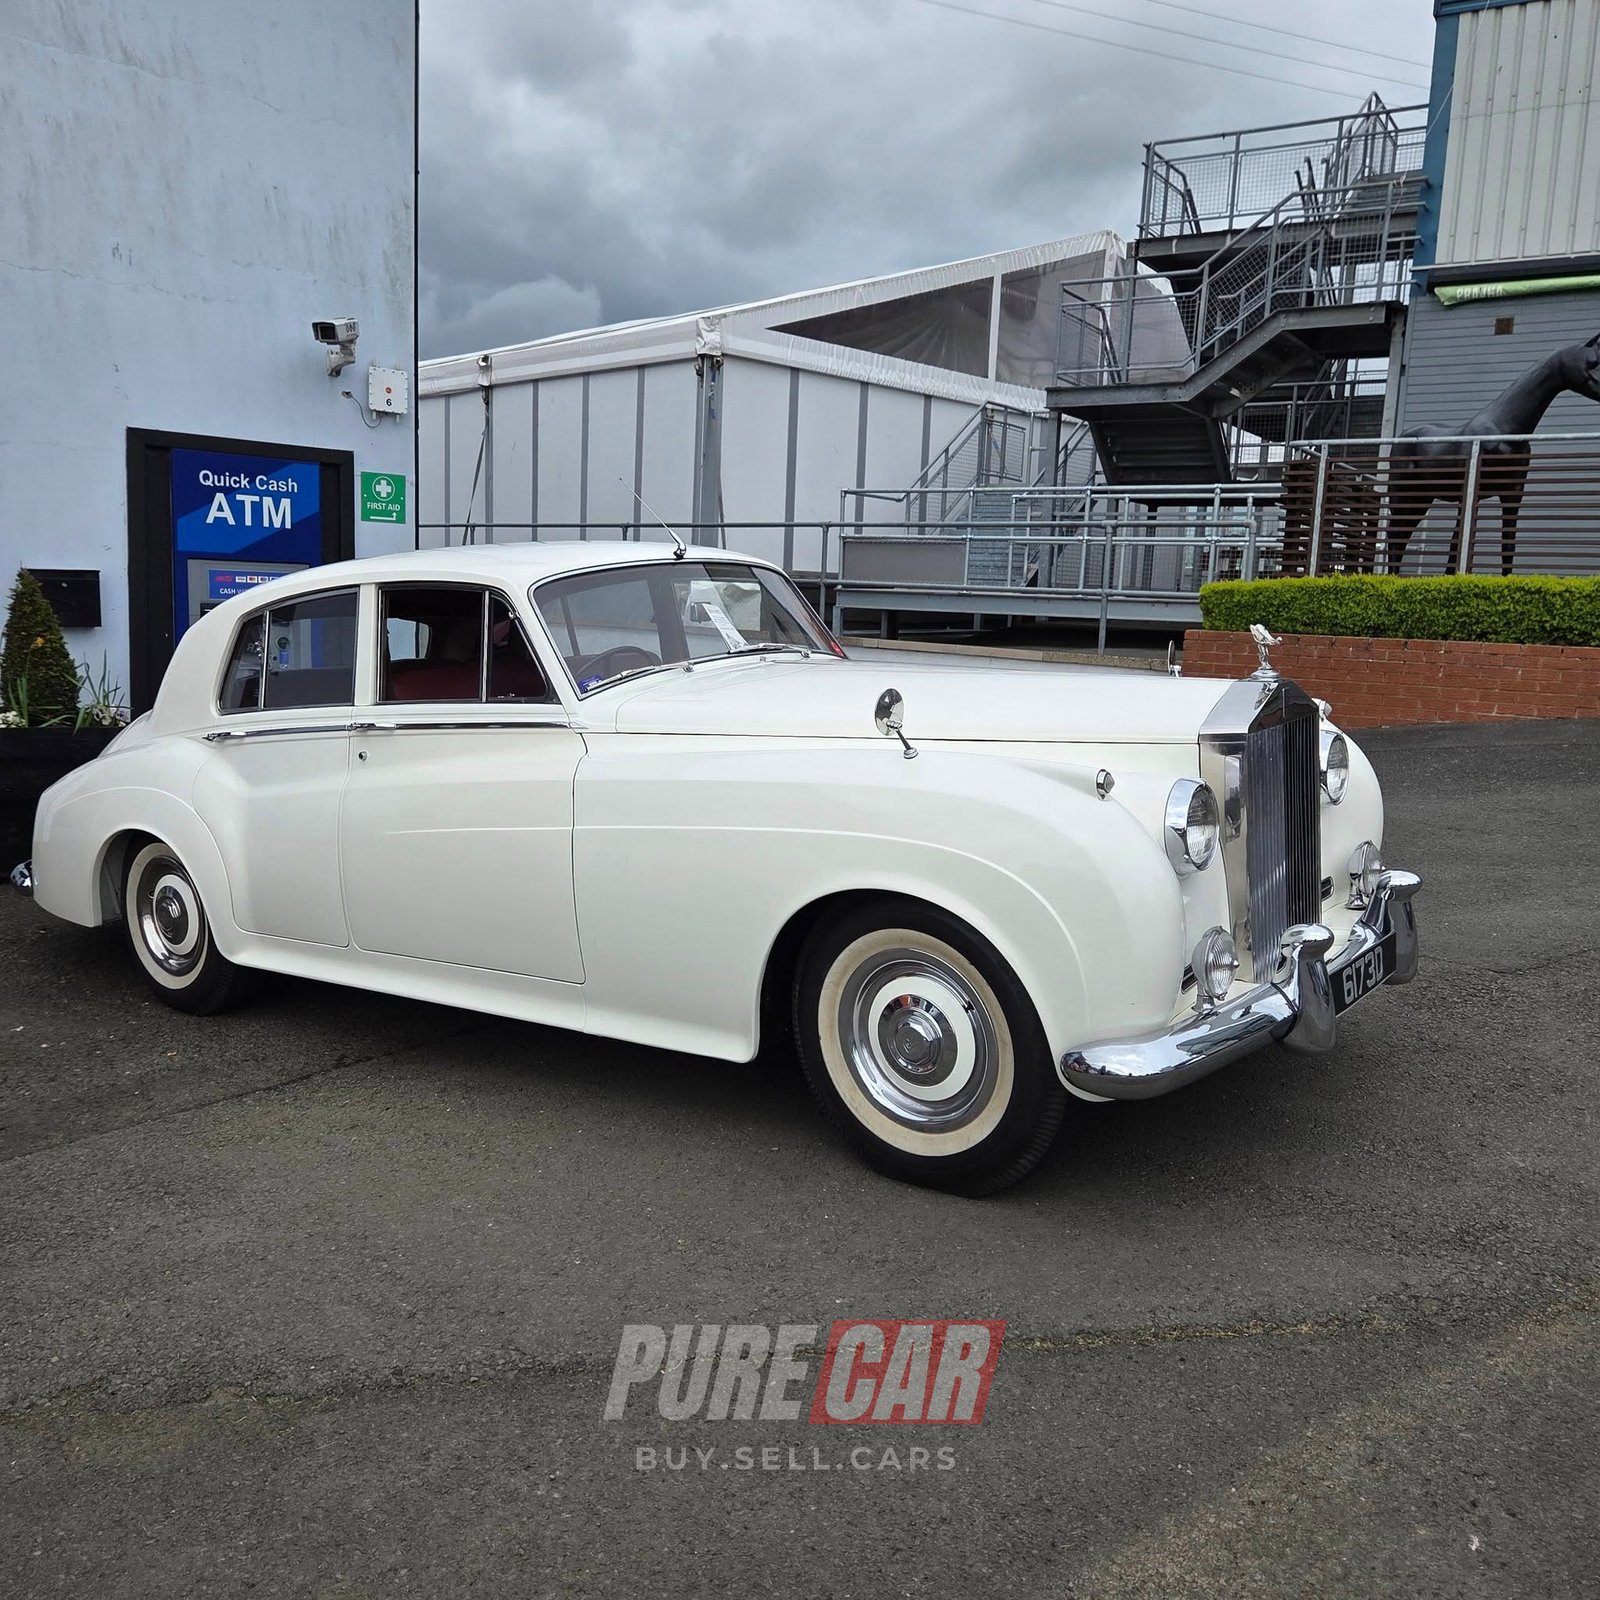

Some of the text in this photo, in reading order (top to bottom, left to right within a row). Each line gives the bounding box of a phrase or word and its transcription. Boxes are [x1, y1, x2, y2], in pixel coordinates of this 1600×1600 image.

[386, 398, 392, 407] 6
[199, 469, 298, 493] Quick Cash
[205, 492, 291, 529] ATM
[367, 501, 401, 511] FIRST AID
[219, 587, 236, 595] CASH
